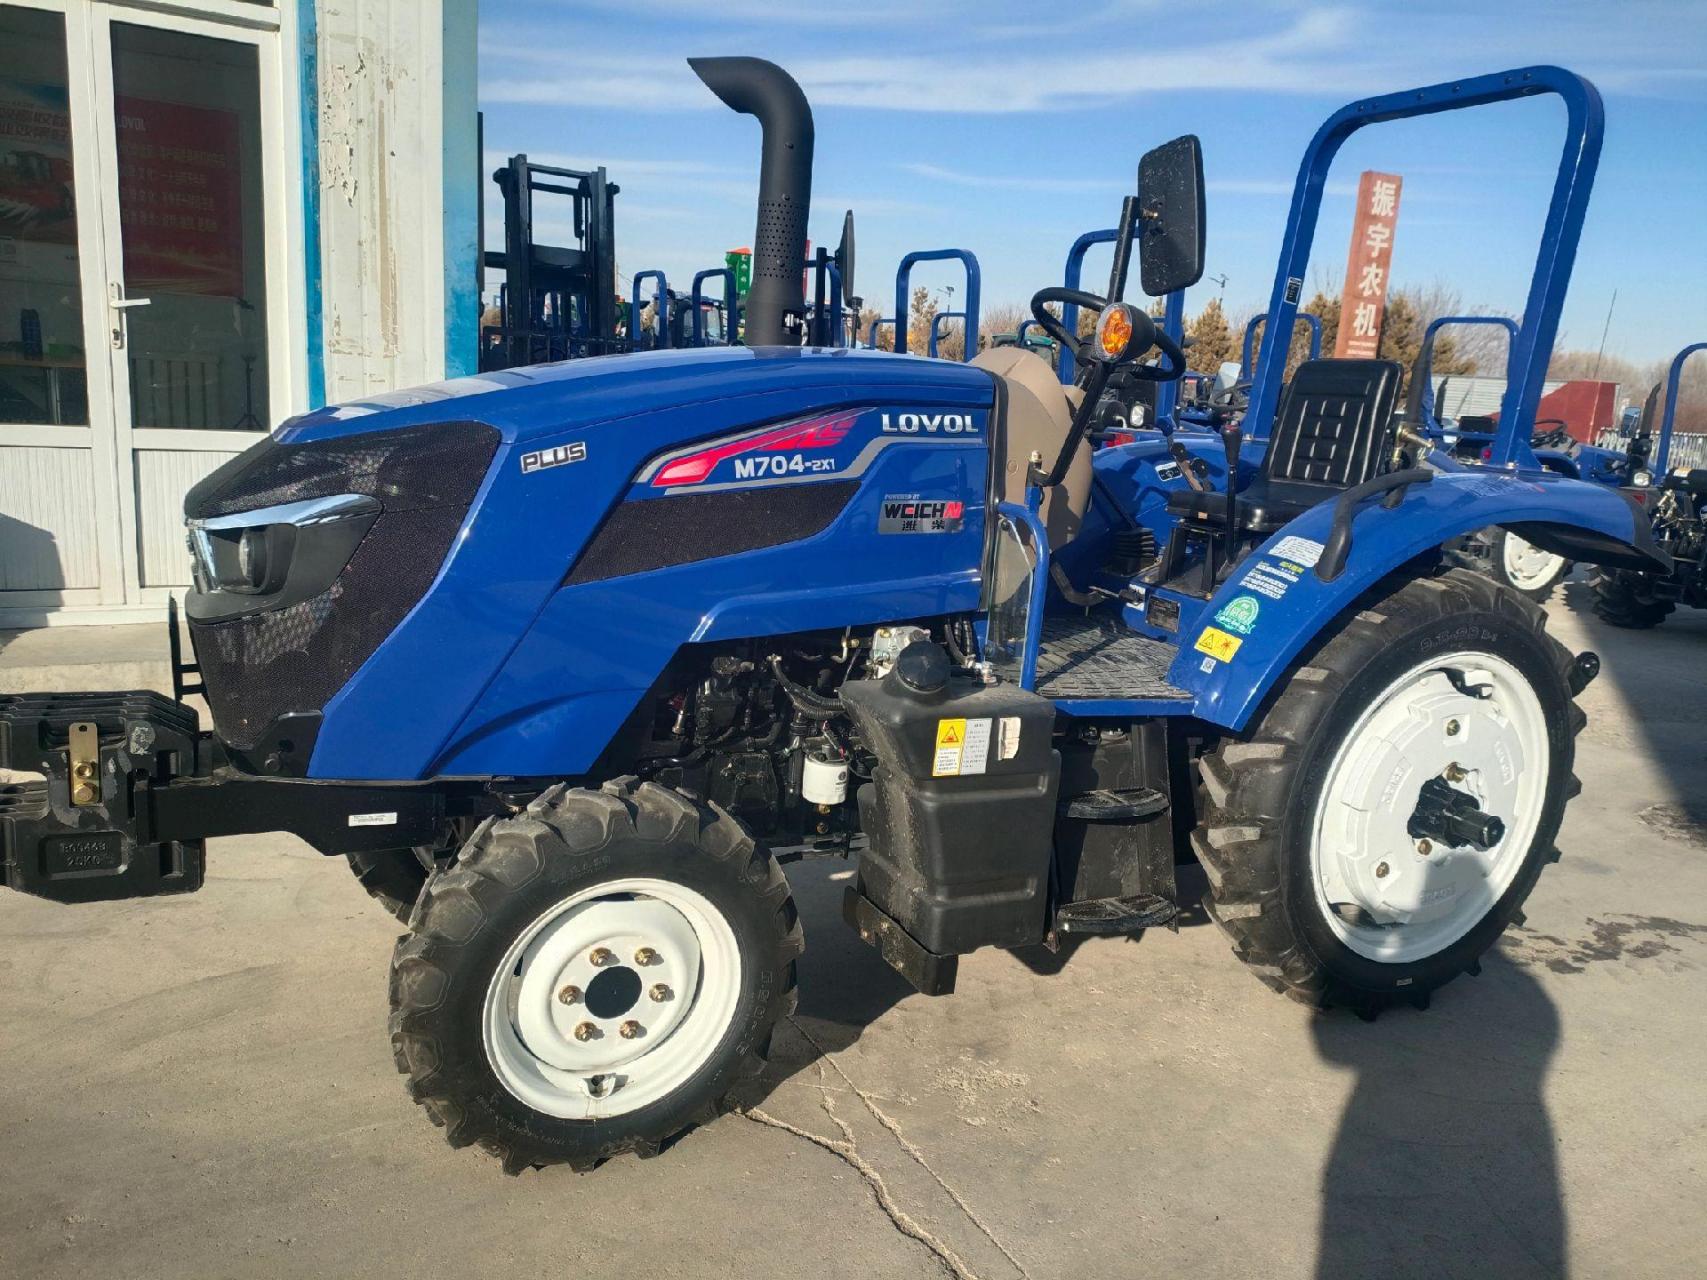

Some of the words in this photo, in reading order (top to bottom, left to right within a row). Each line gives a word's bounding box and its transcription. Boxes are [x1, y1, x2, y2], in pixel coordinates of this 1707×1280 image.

[1353, 180, 1396, 337] 振宇农机
[881, 413, 979, 433] LOVOL
[521, 442, 586, 473] PLUS
